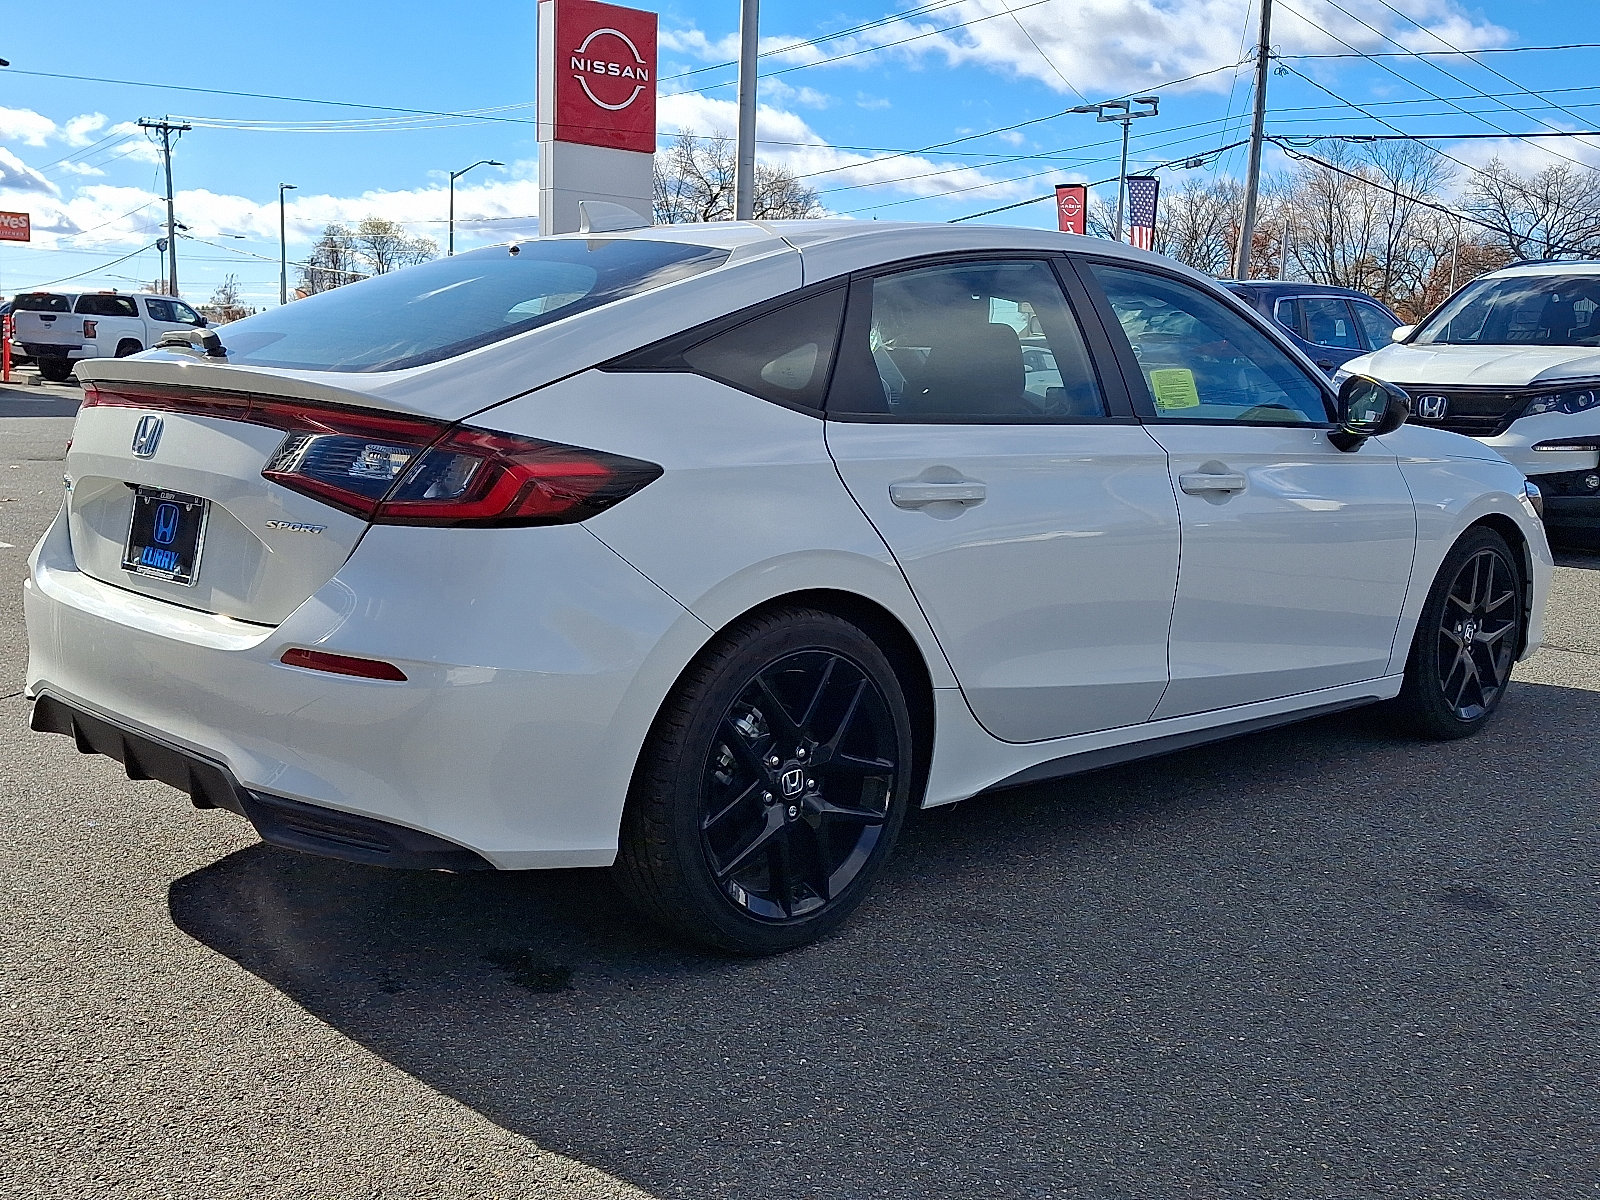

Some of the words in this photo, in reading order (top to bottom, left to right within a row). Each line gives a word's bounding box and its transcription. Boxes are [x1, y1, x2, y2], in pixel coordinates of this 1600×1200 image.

[571, 56, 649, 82] NISSAN
[265, 519, 327, 534] SPORT
[141, 545, 180, 571] CURRY
